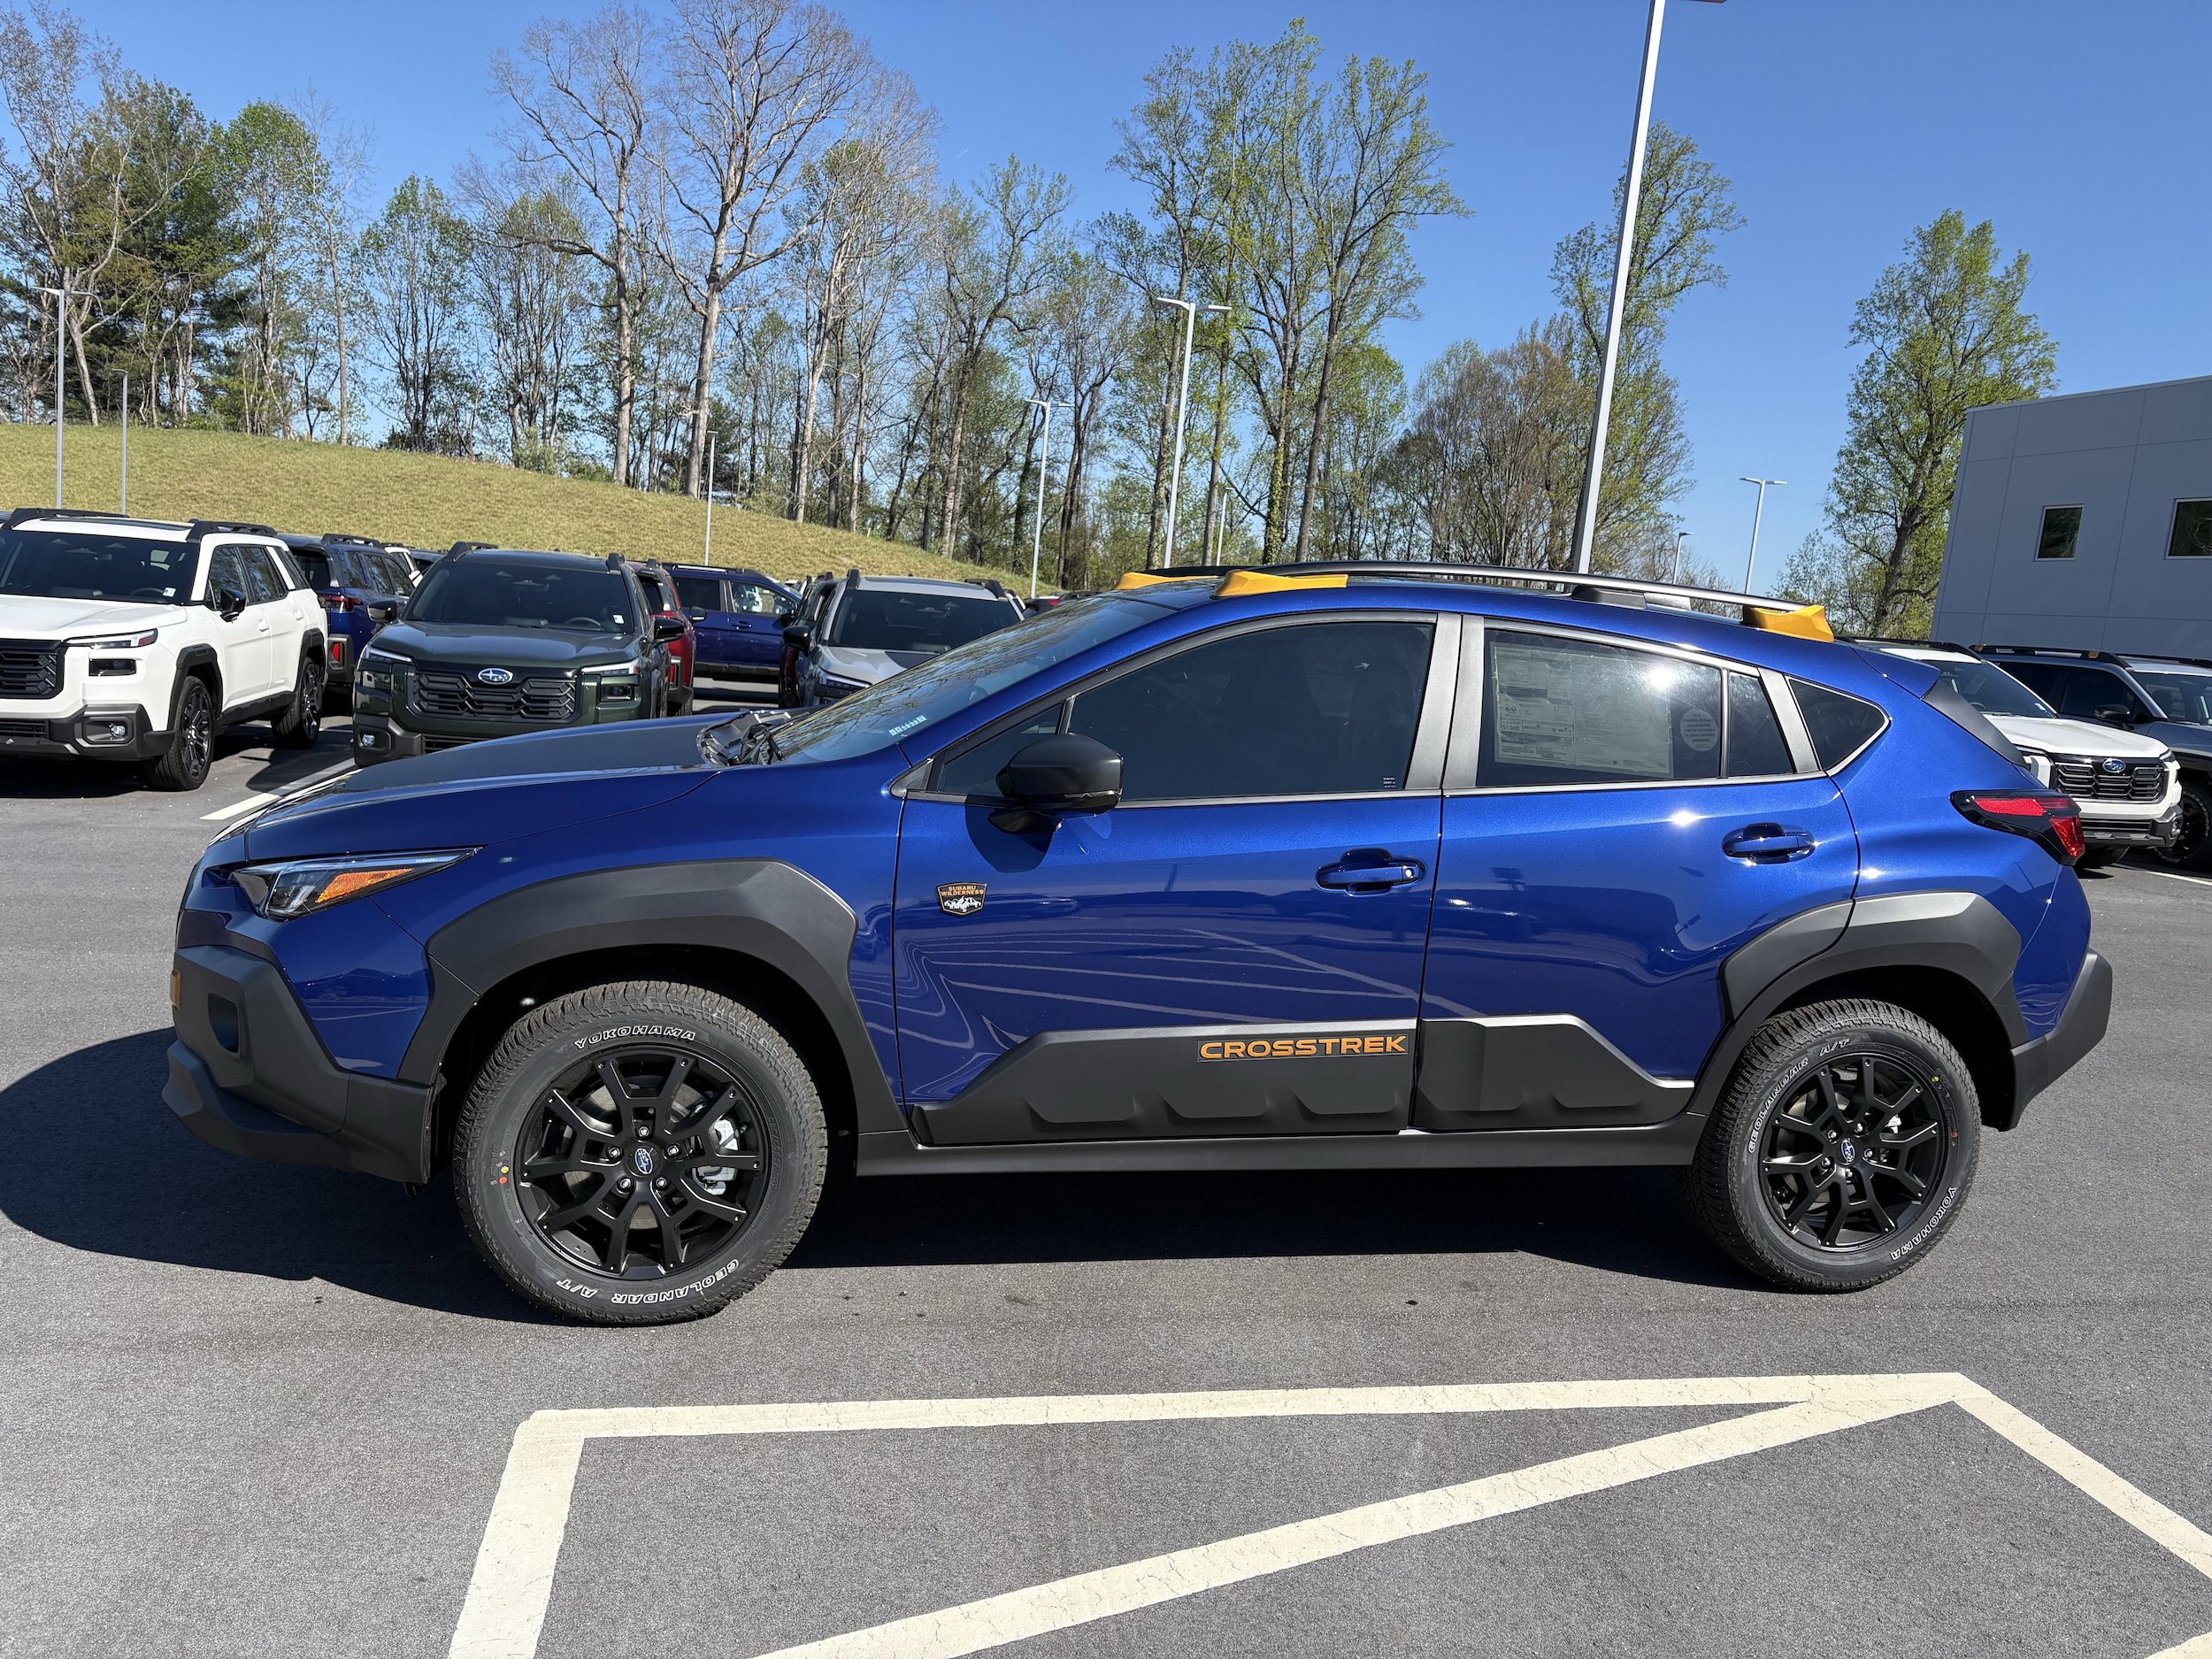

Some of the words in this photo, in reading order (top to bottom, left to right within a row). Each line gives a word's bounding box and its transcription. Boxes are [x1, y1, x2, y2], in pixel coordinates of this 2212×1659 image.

[574, 1025, 696, 1049] YOKOHAMA
[1200, 1035, 1407, 1059] CROSSTREK
[1748, 1057, 1809, 1154] GEOLANDAR
[1818, 1038, 1850, 1056] A/T
[1890, 1187, 1957, 1260] YOKOHAMA
[557, 1279, 598, 1299] A/T
[611, 1258, 739, 1304] GEOLANDAR
